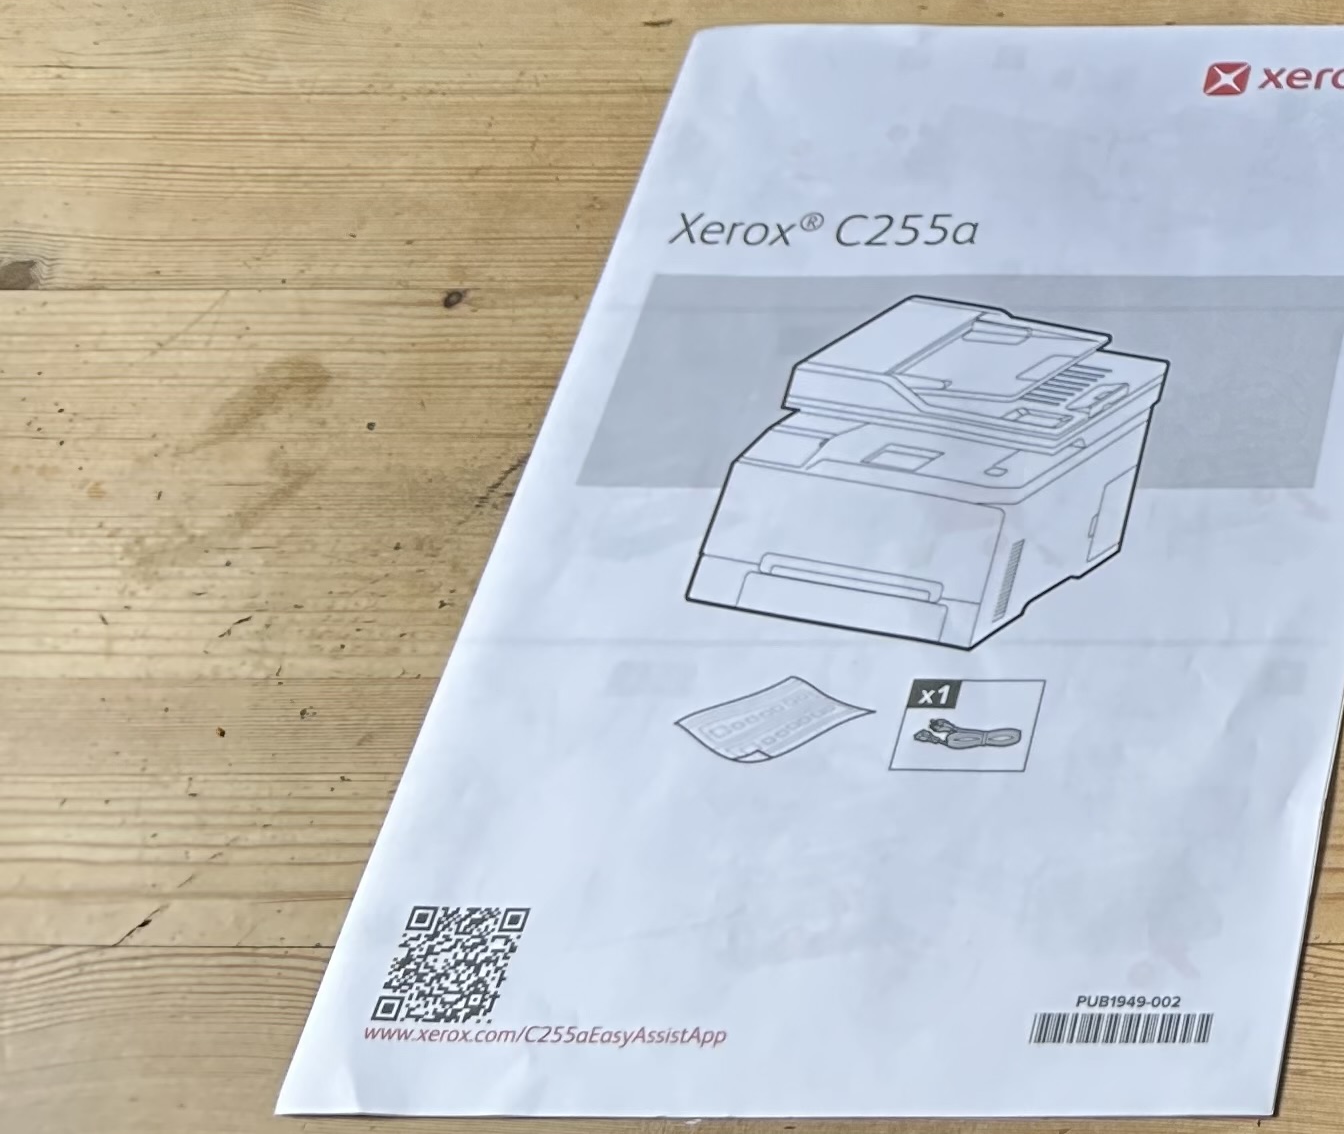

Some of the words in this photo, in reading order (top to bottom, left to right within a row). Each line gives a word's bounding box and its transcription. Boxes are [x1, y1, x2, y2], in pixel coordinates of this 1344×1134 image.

[835, 213, 979, 247] C255a
[917, 683, 951, 705] x1
[1075, 995, 1182, 1008] PUB1949-002
[364, 1025, 727, 1048] www.xerox.com/C255aEasyAssistApp
